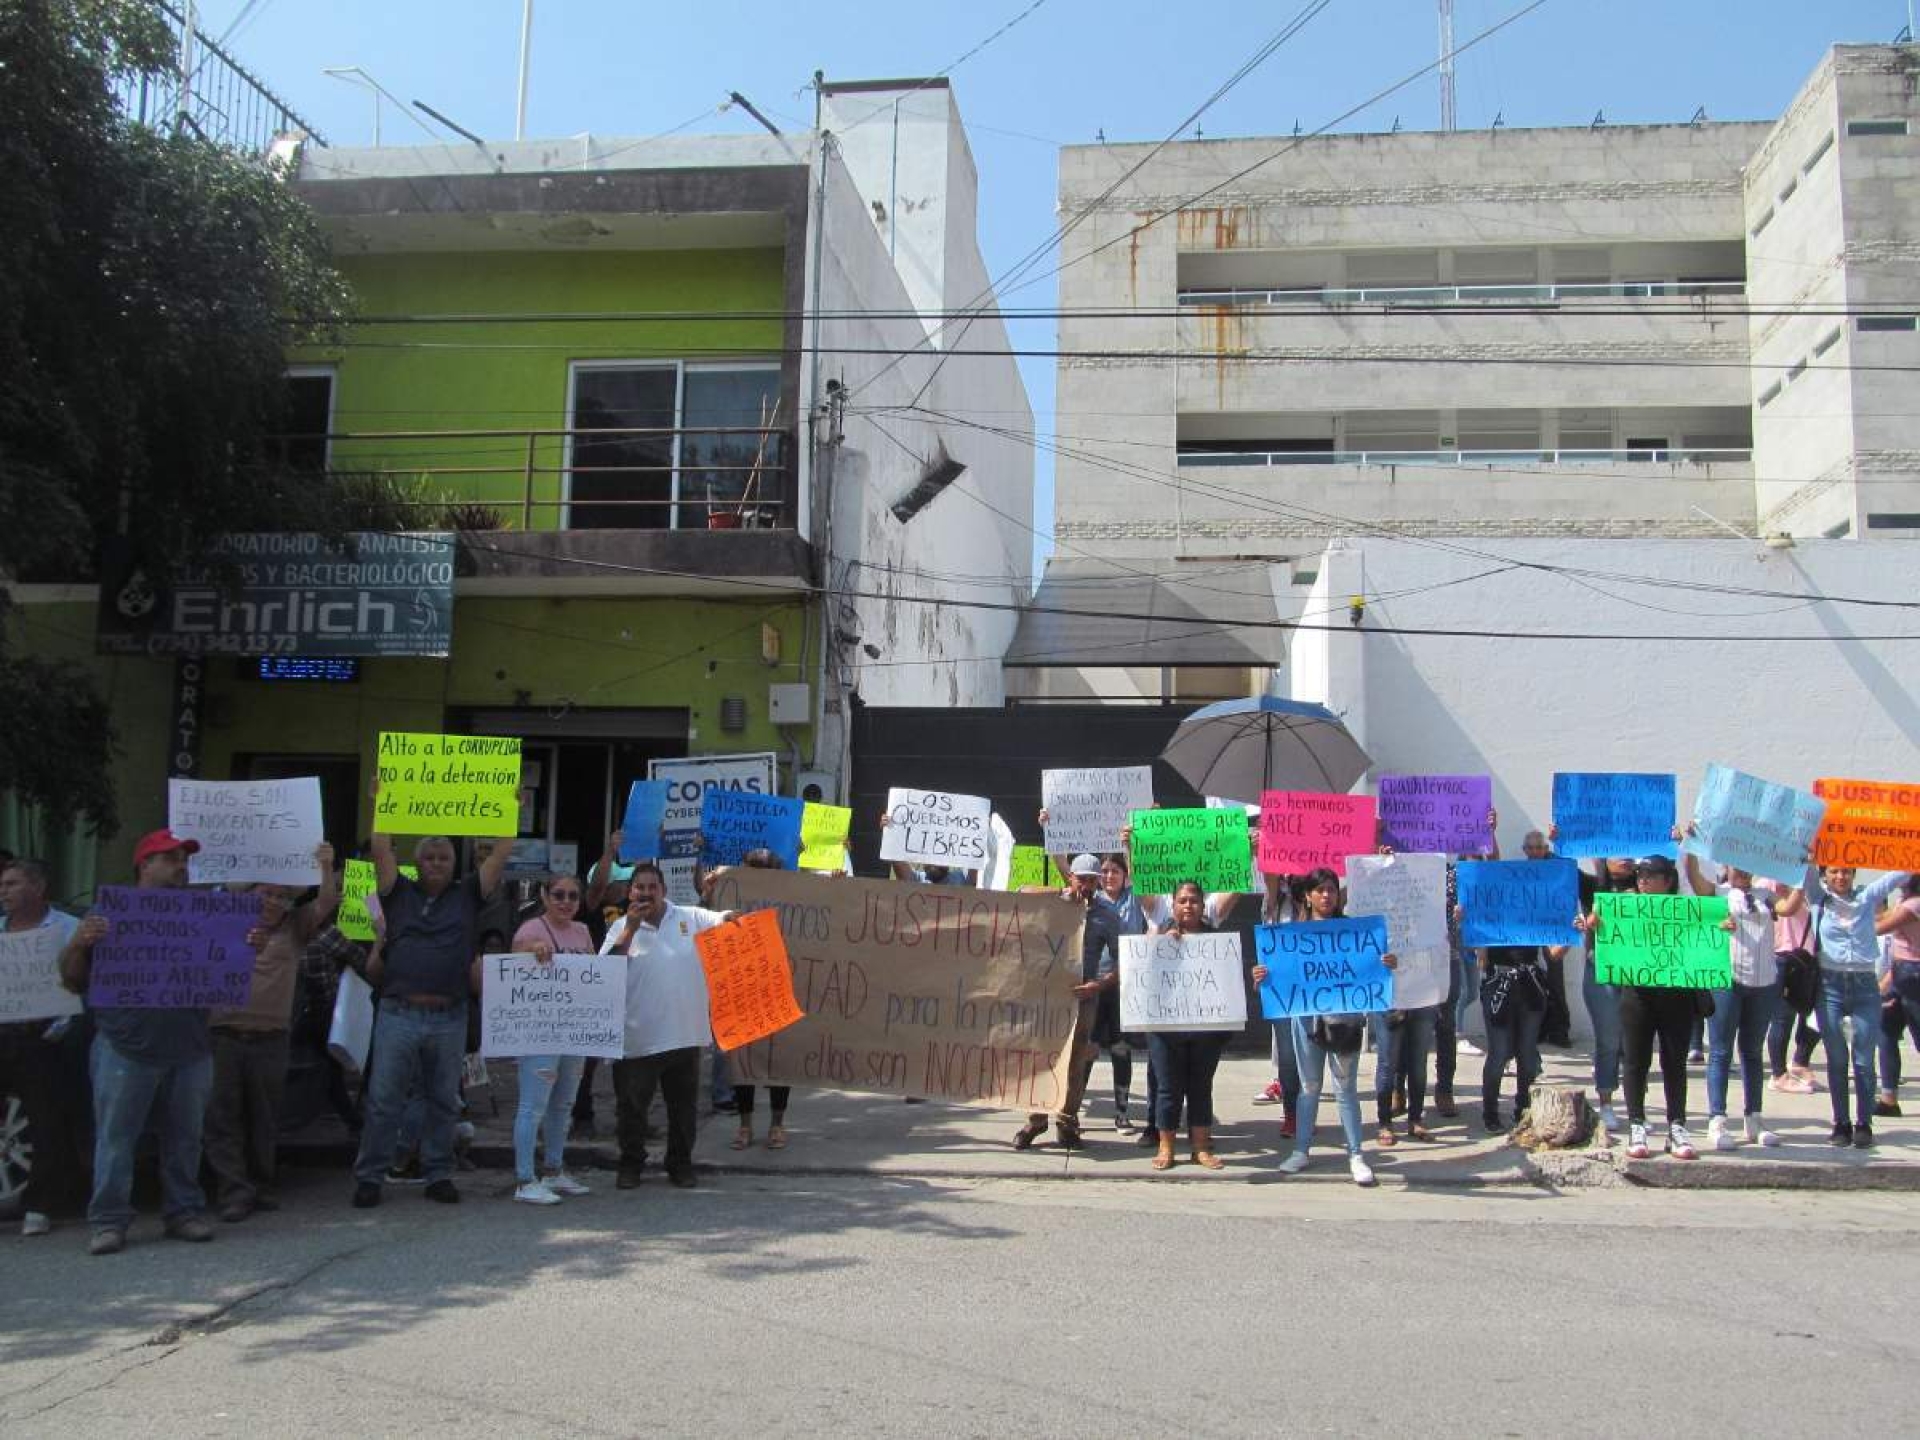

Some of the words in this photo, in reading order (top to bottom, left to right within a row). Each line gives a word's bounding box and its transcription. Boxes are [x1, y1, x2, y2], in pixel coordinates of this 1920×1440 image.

[266, 563, 279, 584] Y
[284, 559, 454, 585] BACTERIOLÓGICO
[381, 734, 417, 756] Alto
[424, 743, 434, 756] a
[442, 735, 454, 756] la
[404, 767, 414, 782] a
[421, 761, 435, 784] la
[378, 792, 398, 815] de
[408, 794, 503, 818] inocentes
[906, 789, 953, 812] LOS
[1287, 792, 1355, 814] hermanos
[890, 804, 981, 832] QUEREMOS
[1215, 812, 1243, 836] que
[1265, 812, 1306, 836] ARCE
[904, 827, 985, 858] LIBRES
[1204, 832, 1220, 852] el
[1815, 837, 1838, 863] NO
[1134, 857, 1187, 875] nombre
[1195, 856, 1212, 873] de
[101, 888, 129, 912] No
[1599, 895, 1703, 922] MERECEN
[116, 919, 201, 944] personas
[845, 889, 1026, 966] JUSTICIA
[1597, 922, 1625, 946] LA
[1631, 921, 1725, 949] LIBERTAD
[207, 938, 227, 962] la
[1261, 925, 1384, 956] JUSTICIA
[1303, 958, 1359, 982] PARA
[1645, 948, 1685, 969] SON
[580, 963, 605, 985] de
[1161, 967, 1219, 992] APOYA
[1604, 964, 1730, 990] INOCENTES
[511, 986, 574, 1005] Morelos
[884, 991, 940, 1037] para
[956, 975, 977, 1030] la
[1269, 981, 1390, 1014] VICTOR
[804, 1031, 856, 1083] ellos
[866, 1051, 908, 1089] son
[923, 1039, 1062, 1110] INOCENTES
